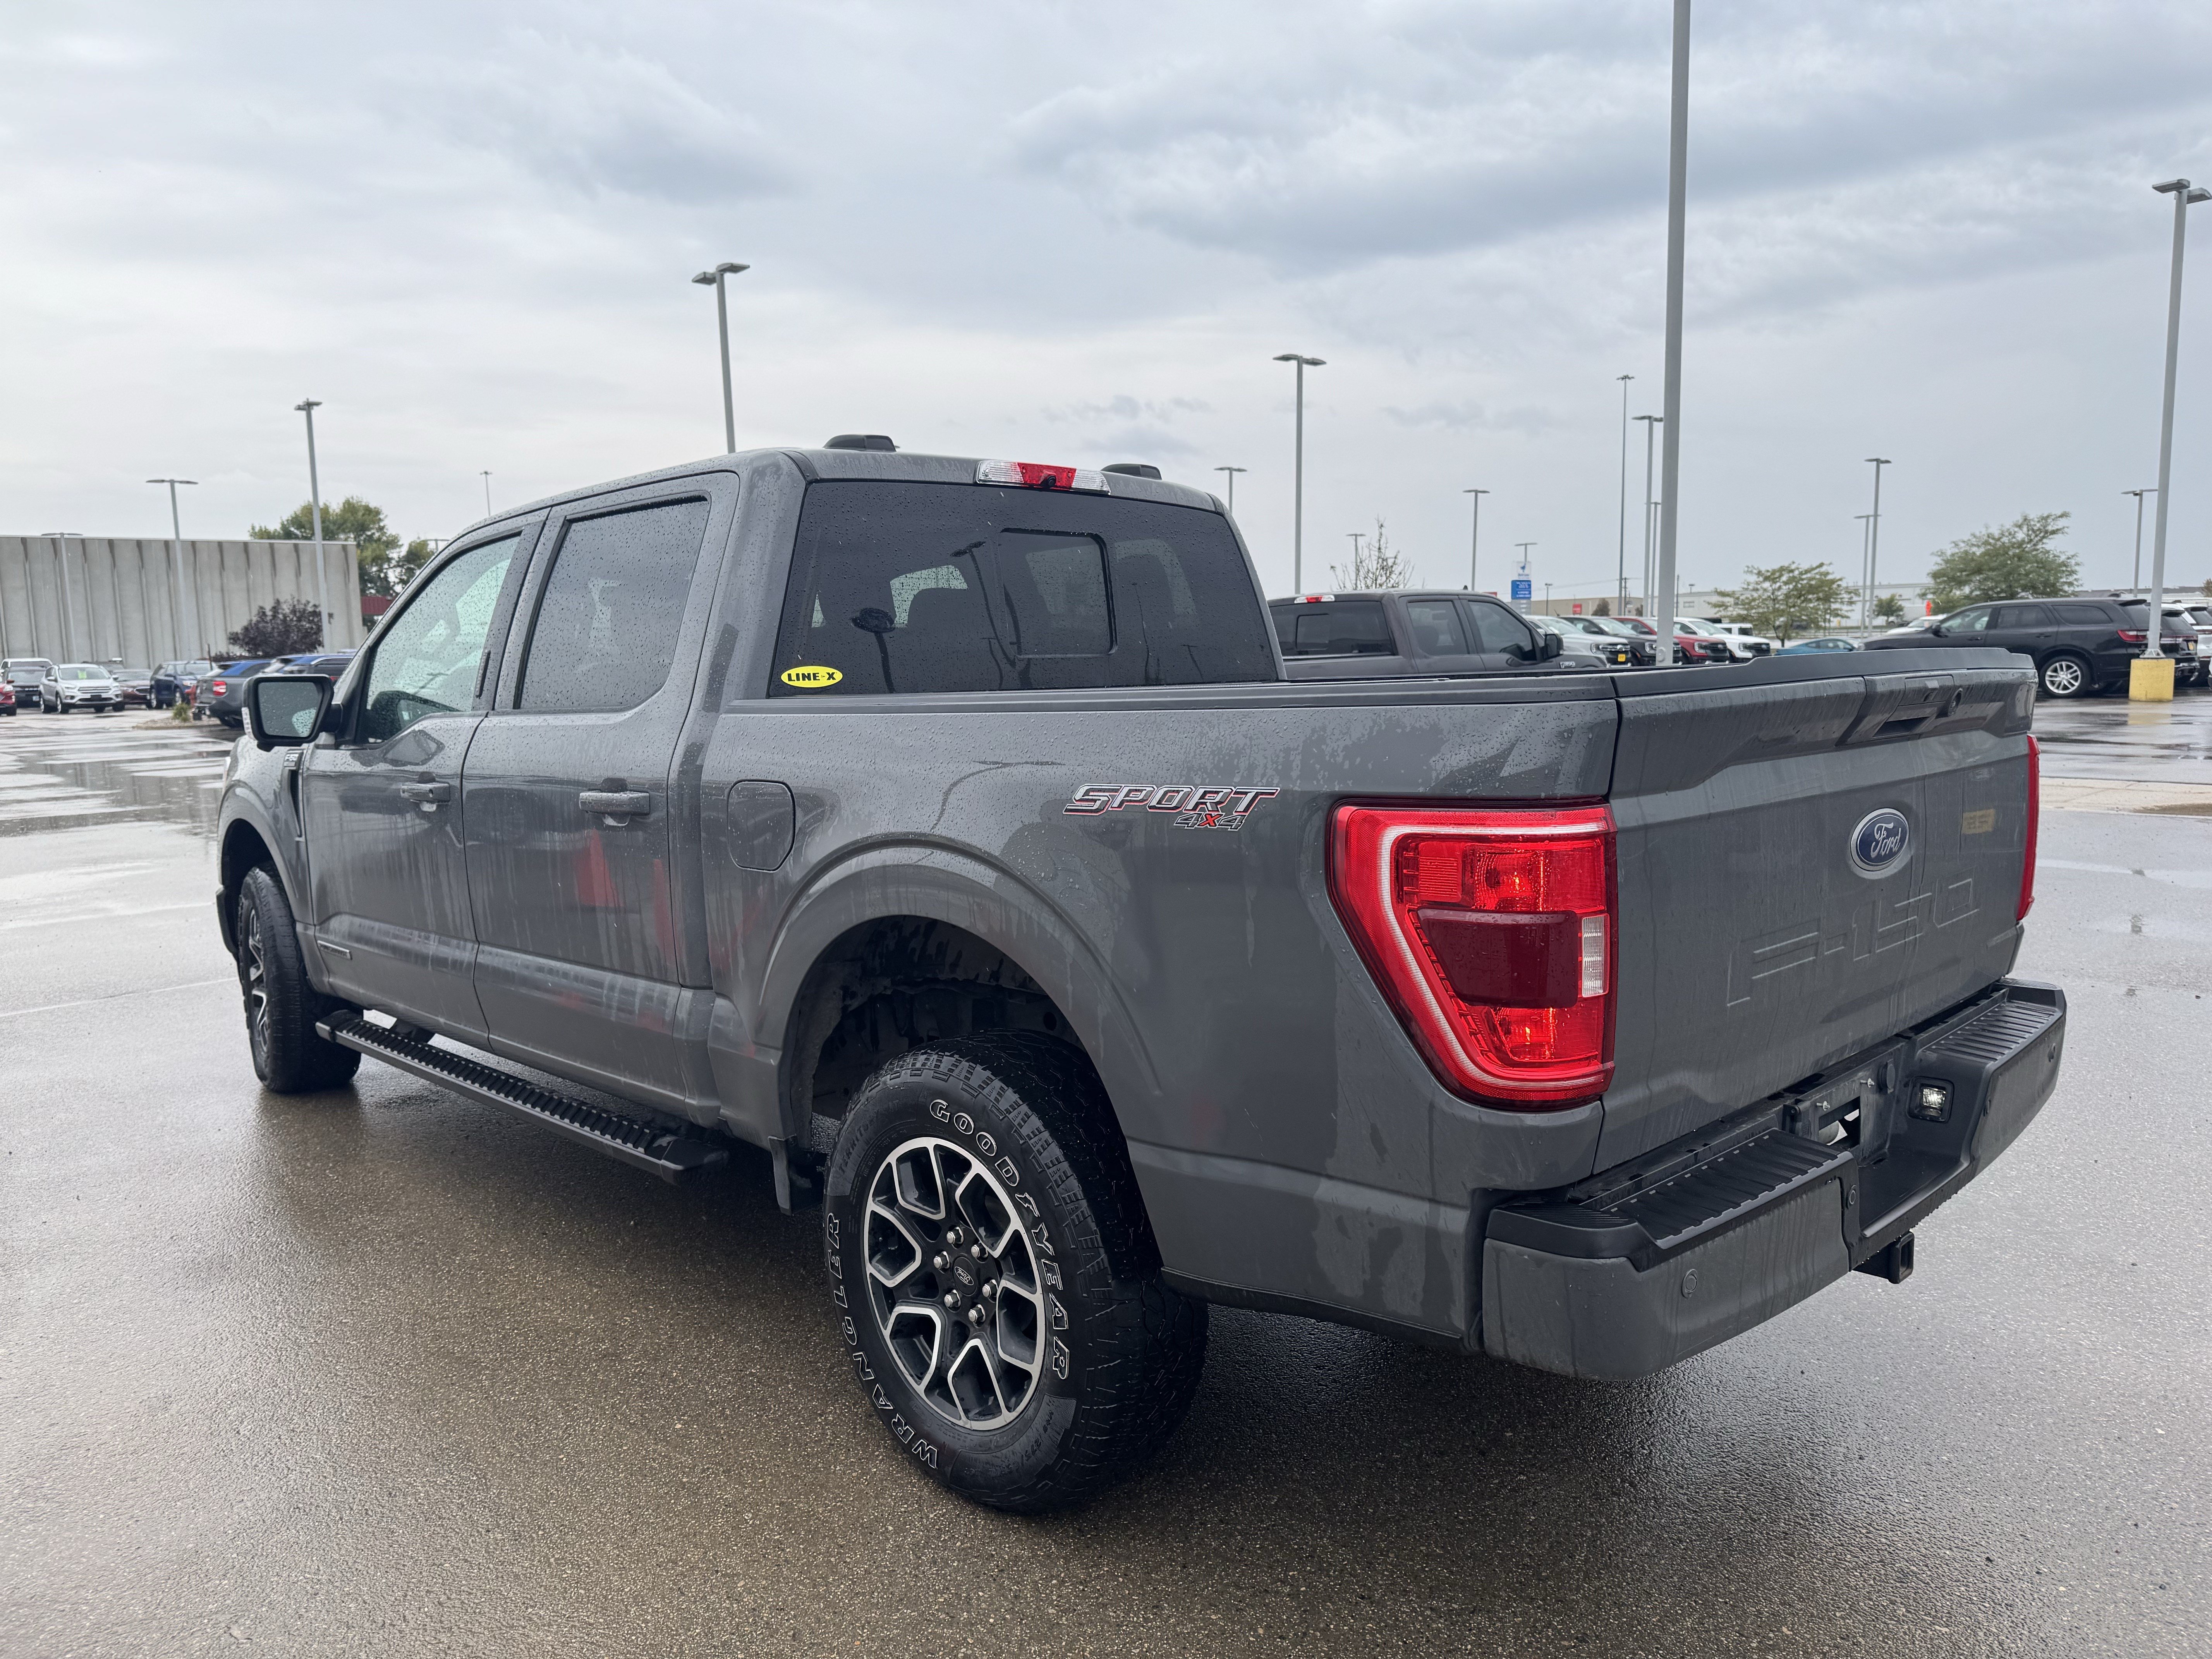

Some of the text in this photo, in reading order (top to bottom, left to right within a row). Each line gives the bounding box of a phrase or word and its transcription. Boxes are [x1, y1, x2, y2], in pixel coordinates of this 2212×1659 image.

[787, 672, 836, 682] LINE-X
[1063, 783, 1280, 815] SPORT
[1870, 822, 1901, 859] Ford
[1727, 867, 1979, 1006] F-150
[929, 1099, 1070, 1380] GOODYEAR
[957, 1269, 970, 1283] Ford
[826, 1212, 939, 1470] WRANGLER
